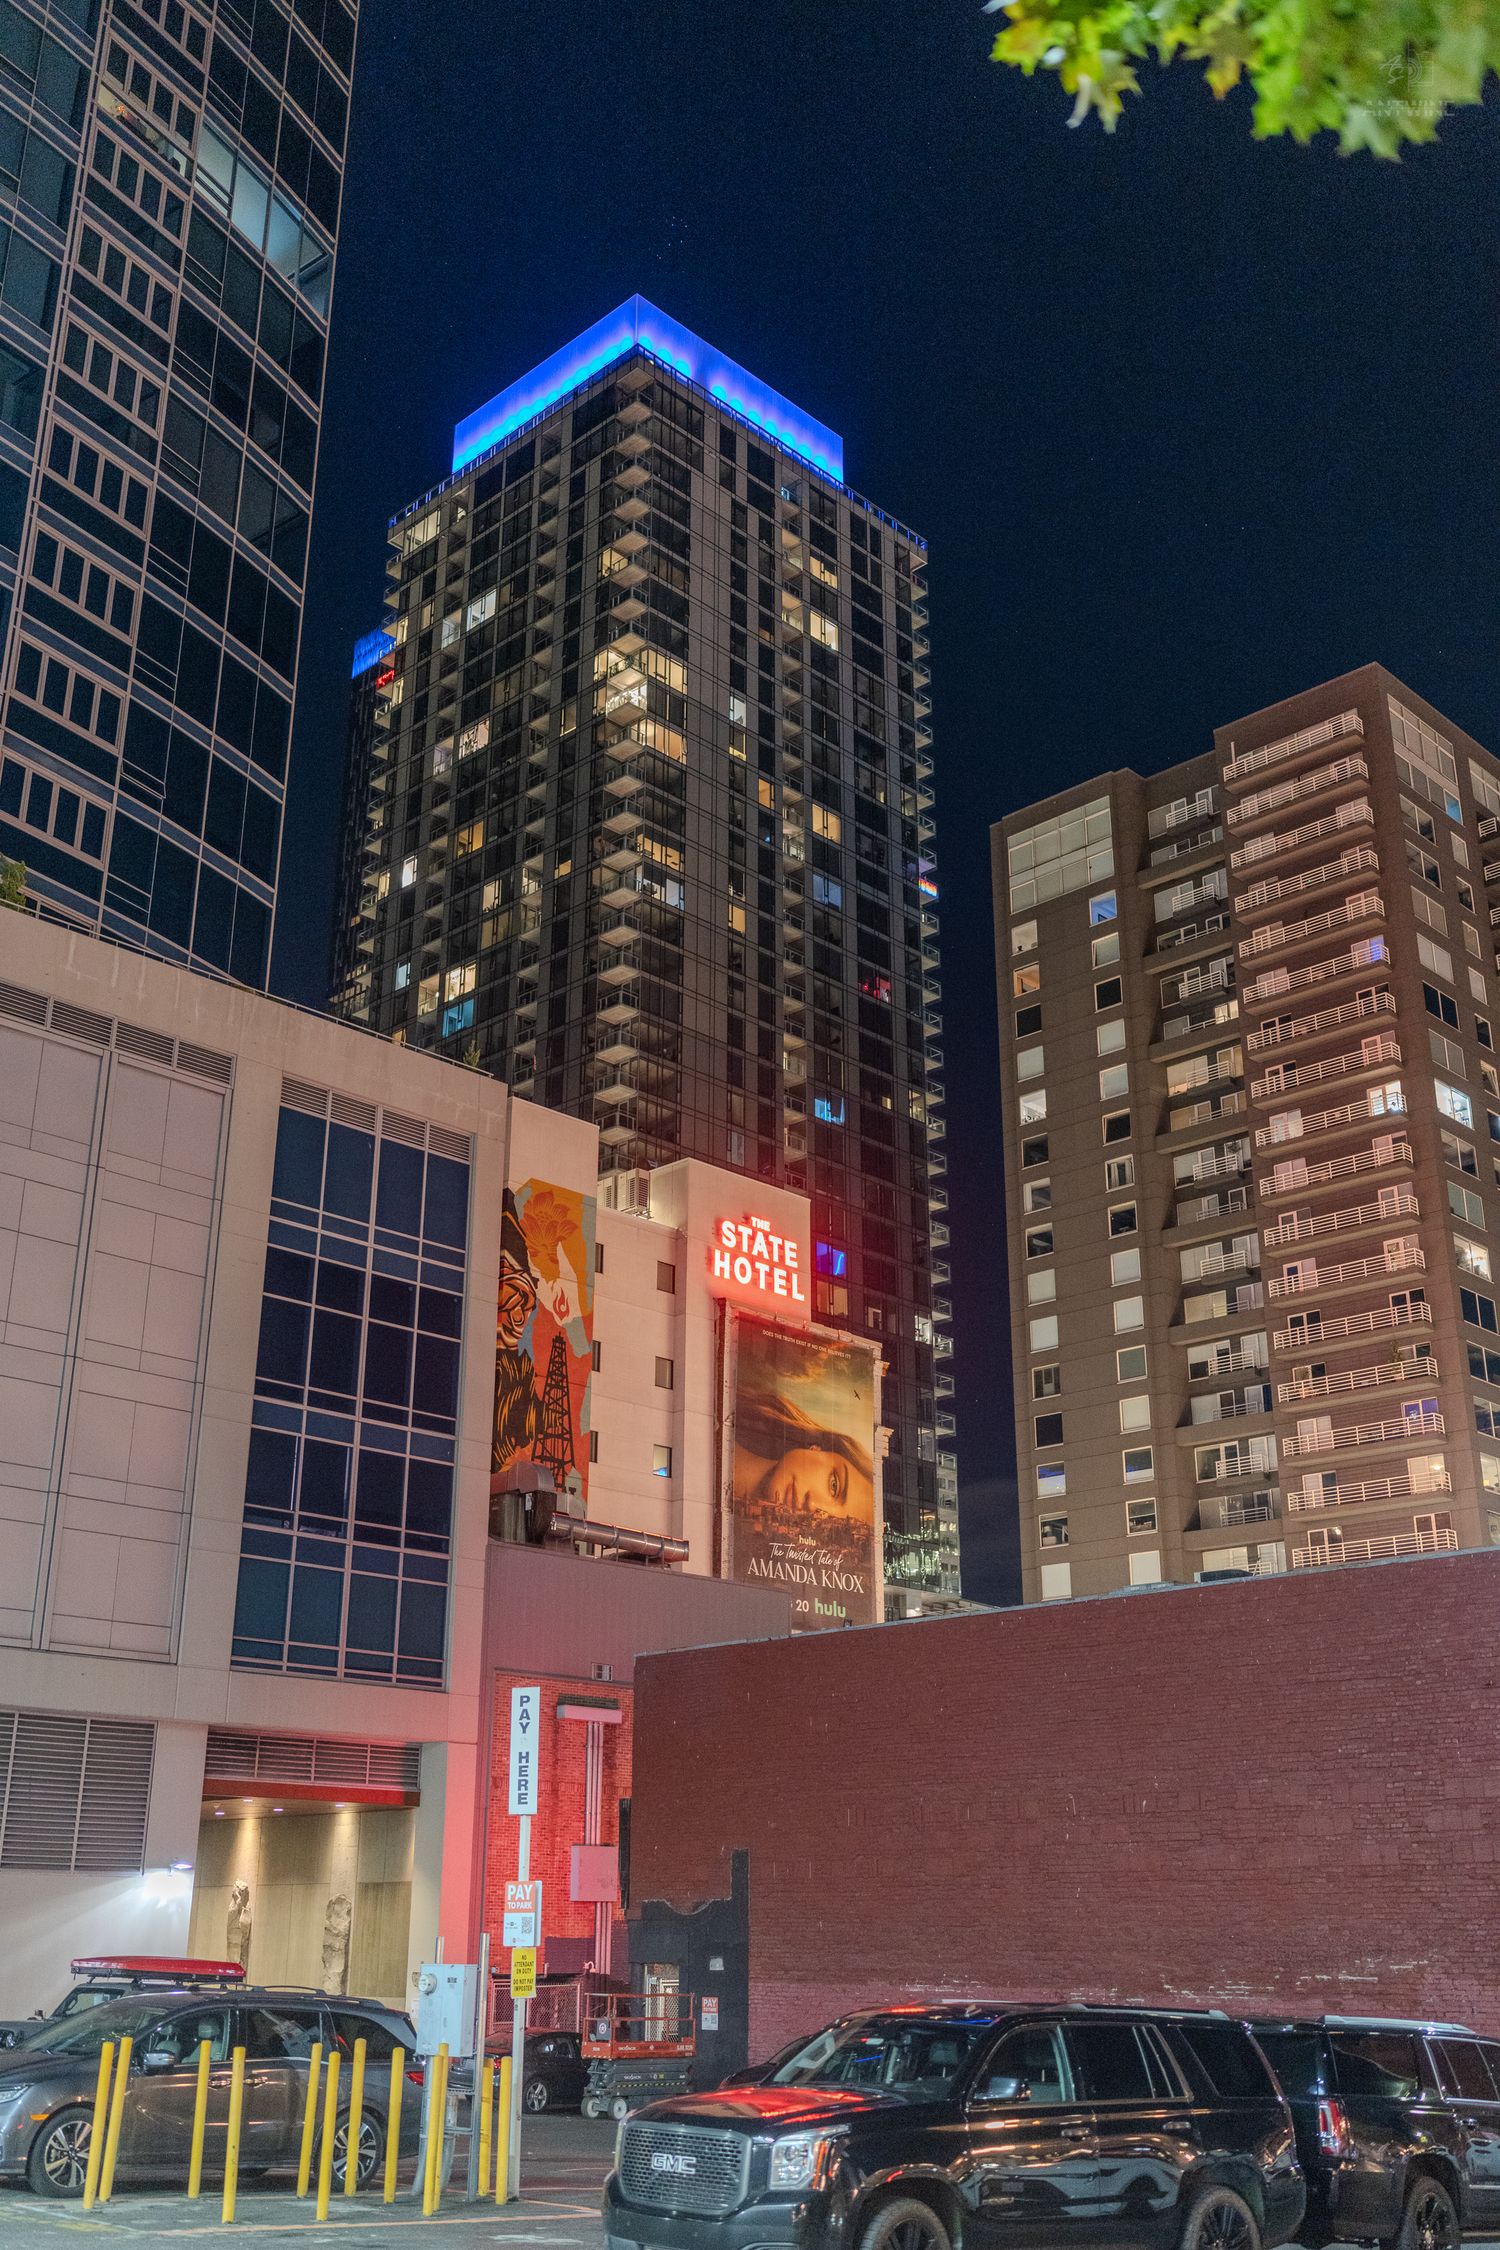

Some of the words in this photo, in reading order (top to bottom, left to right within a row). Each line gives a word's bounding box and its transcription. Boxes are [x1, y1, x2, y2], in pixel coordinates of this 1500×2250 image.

[751, 1216, 771, 1232] THE
[721, 1220, 799, 1268] STATE
[713, 1248, 805, 1302] HOTEL
[774, 1332, 782, 1340] THE
[799, 1534, 817, 1546] hulu
[769, 1542, 785, 1558] The
[784, 1543, 816, 1565] Twisted
[815, 1549, 833, 1566] Tale
[833, 1553, 844, 1572] of
[747, 1557, 818, 1586] AMANDA
[821, 1569, 865, 1594] KNOX
[795, 1599, 810, 1613] 20
[815, 1598, 847, 1618] hulu
[518, 1695, 531, 1734] PAY
[517, 1751, 530, 1806] HERE
[507, 1884, 533, 1901] PAY
[508, 1901, 516, 1910] TO
[516, 1901, 532, 1910] PARK
[703, 1998, 717, 2008] PAY
[651, 2152, 697, 2175] GMC
